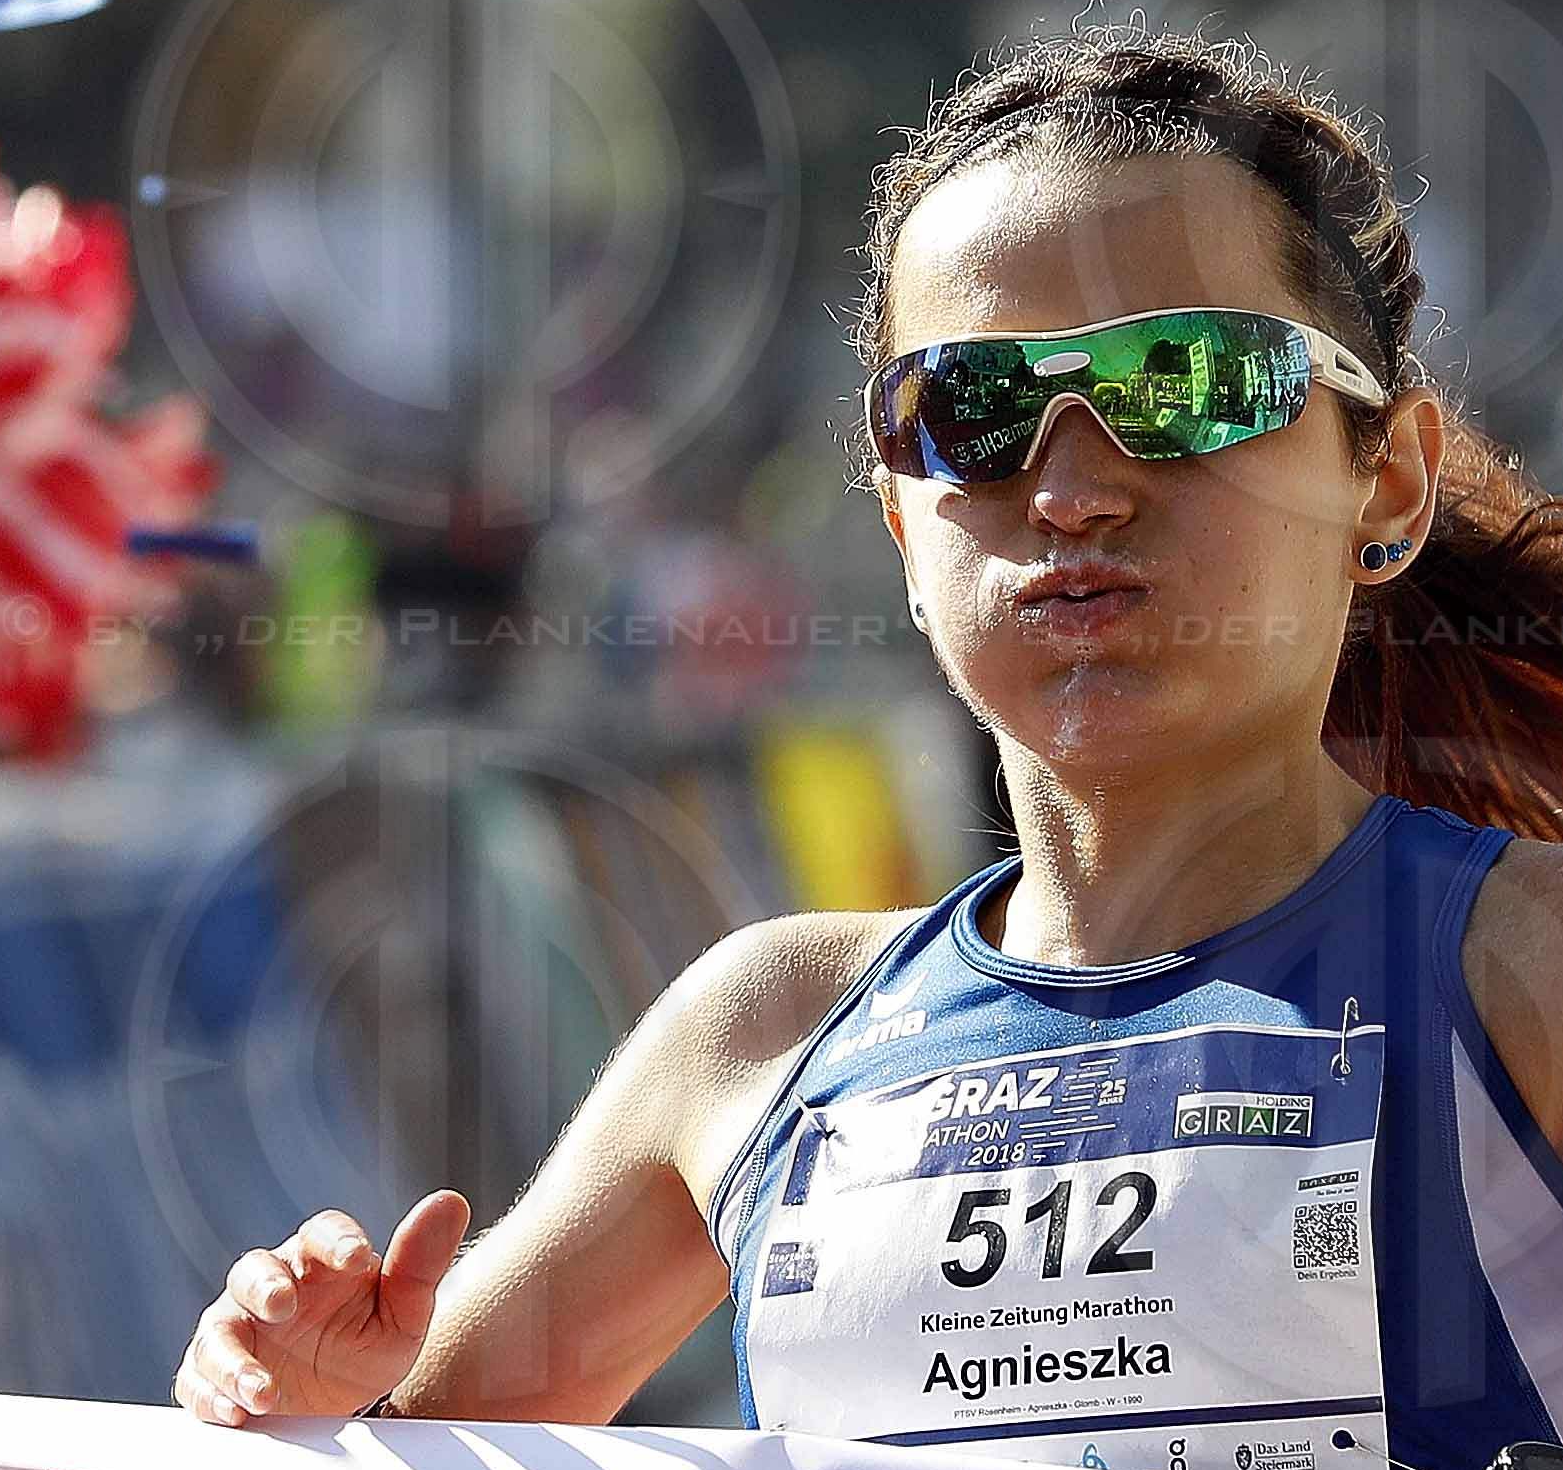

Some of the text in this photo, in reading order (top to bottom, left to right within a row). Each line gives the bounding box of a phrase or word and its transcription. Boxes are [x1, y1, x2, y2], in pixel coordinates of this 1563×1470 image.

[1256, 1096, 1311, 1107] HOLDING
[1179, 1109, 1303, 1135] GRAZ
[968, 1142, 1026, 1167] 2018
[941, 1171, 1158, 1289] 512
[921, 1295, 1173, 1333] Kleine Zeitung Marathon
[922, 1336, 1172, 1400] Agnieszka
[1257, 1440, 1311, 1455] Das Land
